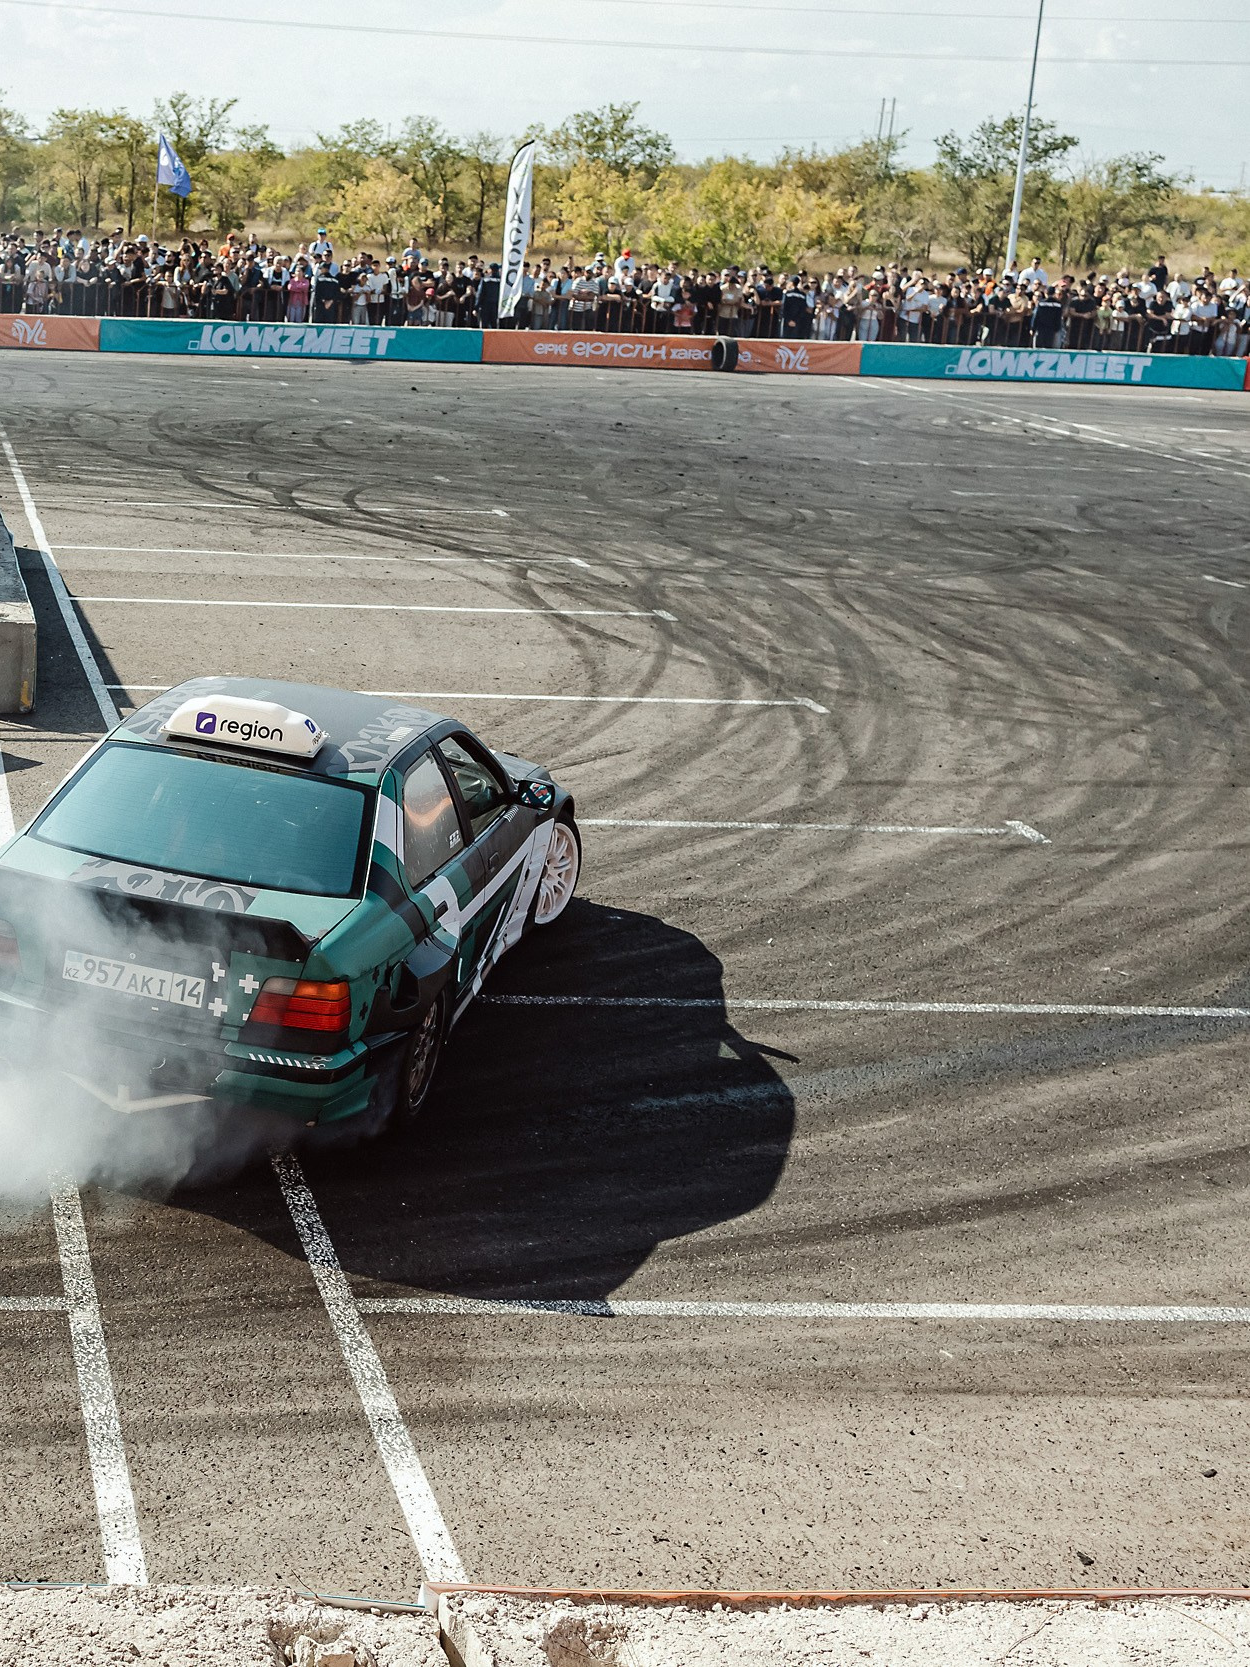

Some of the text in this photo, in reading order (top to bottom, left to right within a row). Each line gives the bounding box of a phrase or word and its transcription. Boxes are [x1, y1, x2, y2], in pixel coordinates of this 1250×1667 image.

[200, 325, 396, 356] LOWKZMEET
[955, 350, 1153, 381] LOWKZMEET
[220, 719, 284, 742] region
[64, 958, 202, 1005] KZ 957 AKI 14
